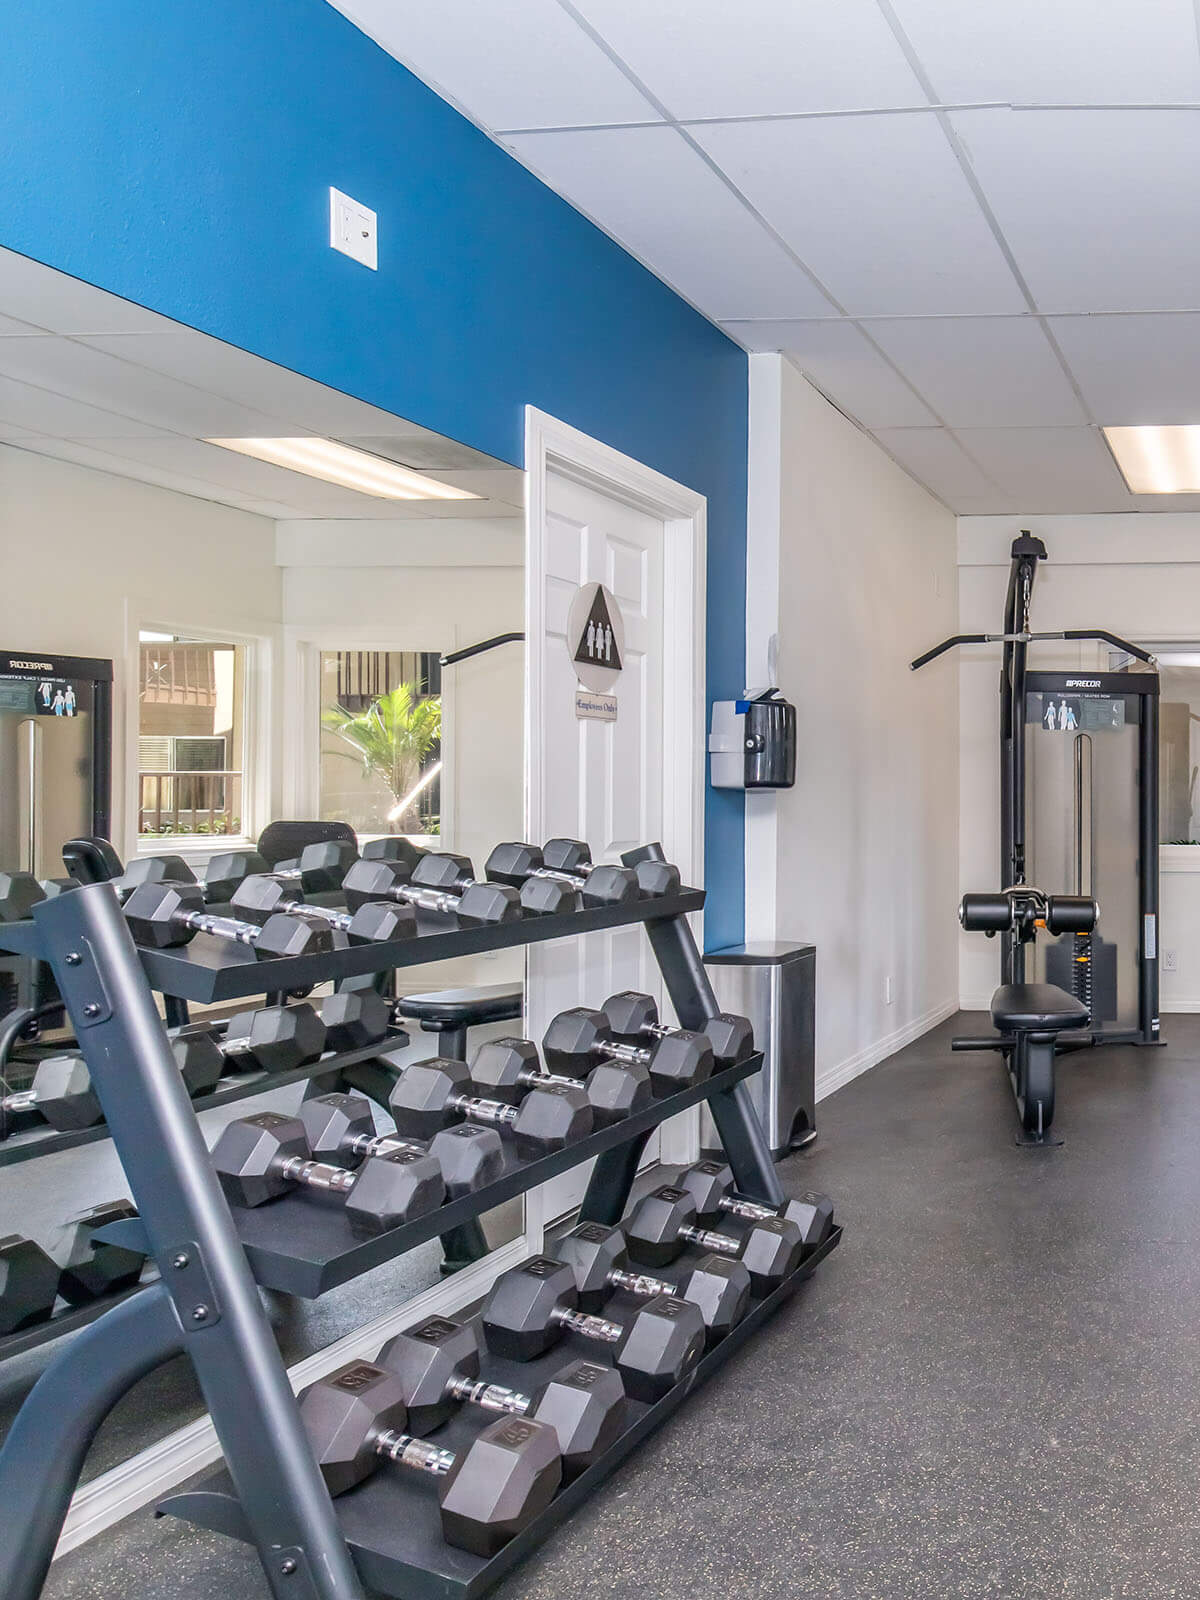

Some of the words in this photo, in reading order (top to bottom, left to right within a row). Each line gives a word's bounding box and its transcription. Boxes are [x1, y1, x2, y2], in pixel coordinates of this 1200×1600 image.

[1070, 679, 1101, 688] PRECOR
[577, 699, 603, 711] Employees
[604, 702, 615, 713] Only
[340, 1370, 370, 1388] 45
[502, 1427, 529, 1445] 45
